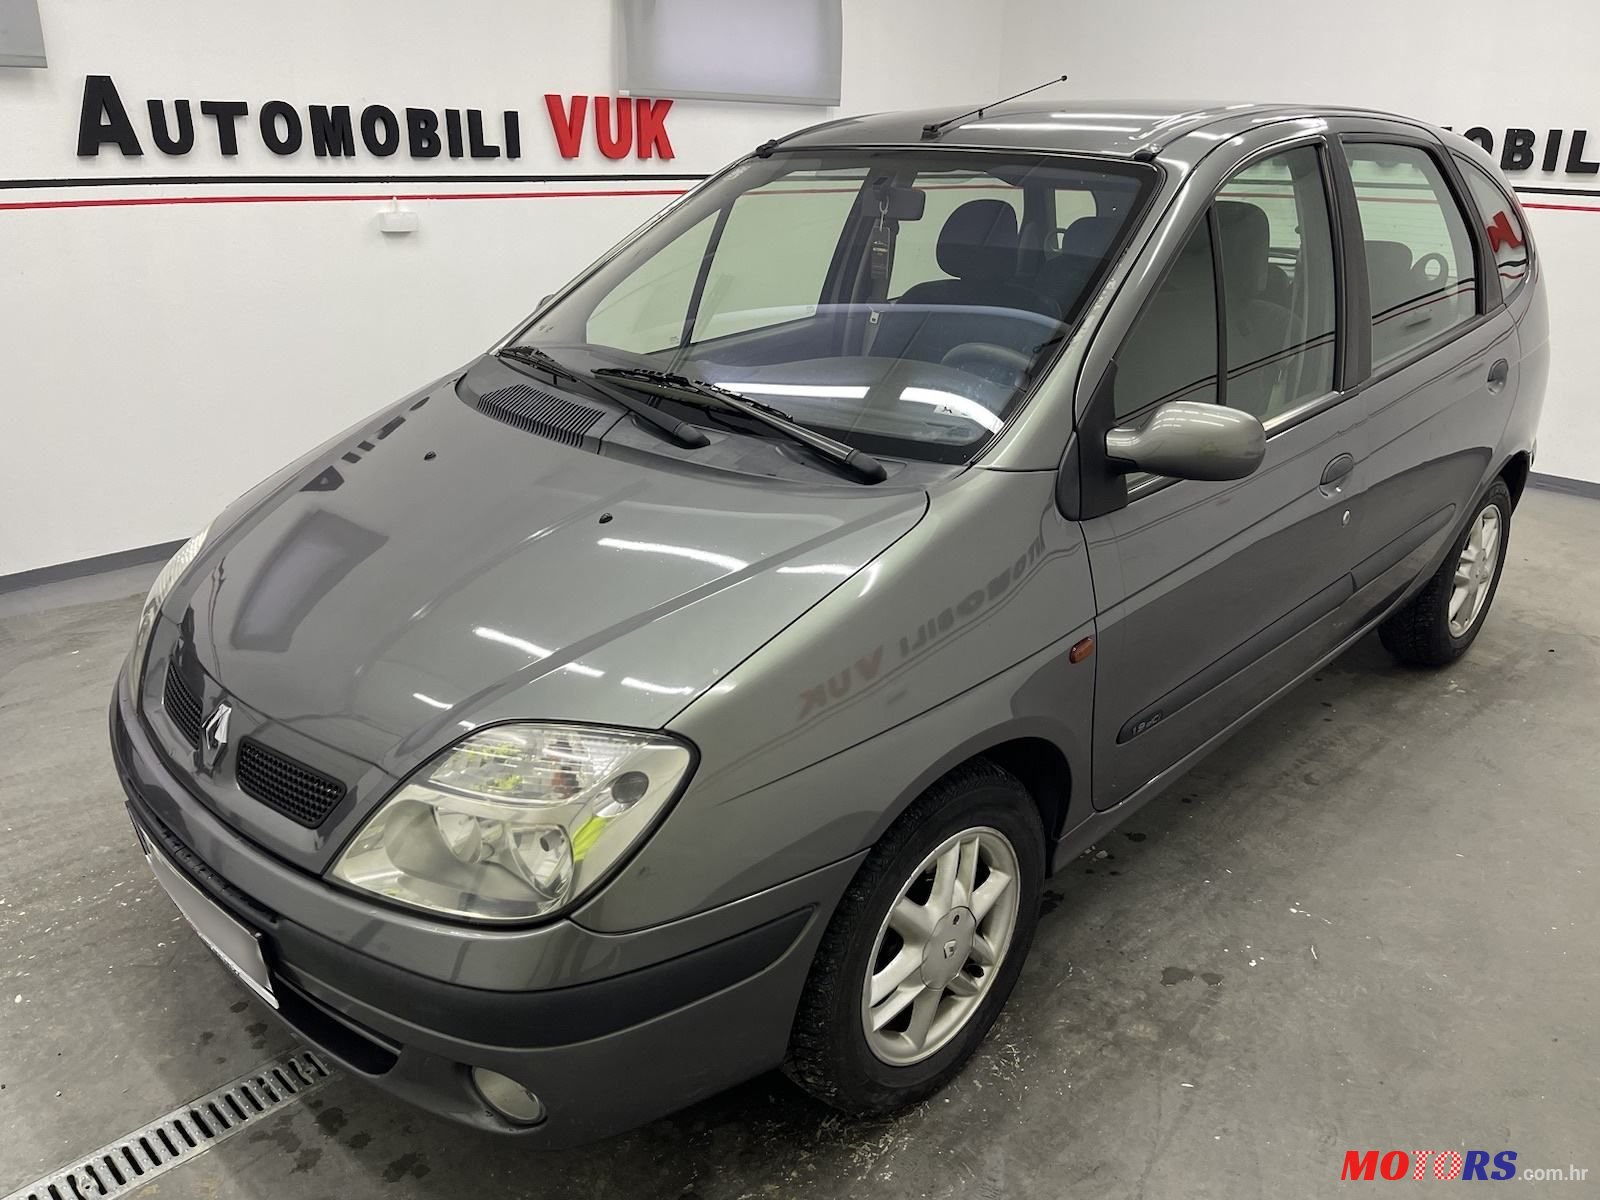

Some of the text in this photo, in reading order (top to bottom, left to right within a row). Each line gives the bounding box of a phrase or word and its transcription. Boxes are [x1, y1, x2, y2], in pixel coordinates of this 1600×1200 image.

[77, 75, 674, 160] AUTOMOBILI VUK
[1441, 127, 1600, 173] OBIL
